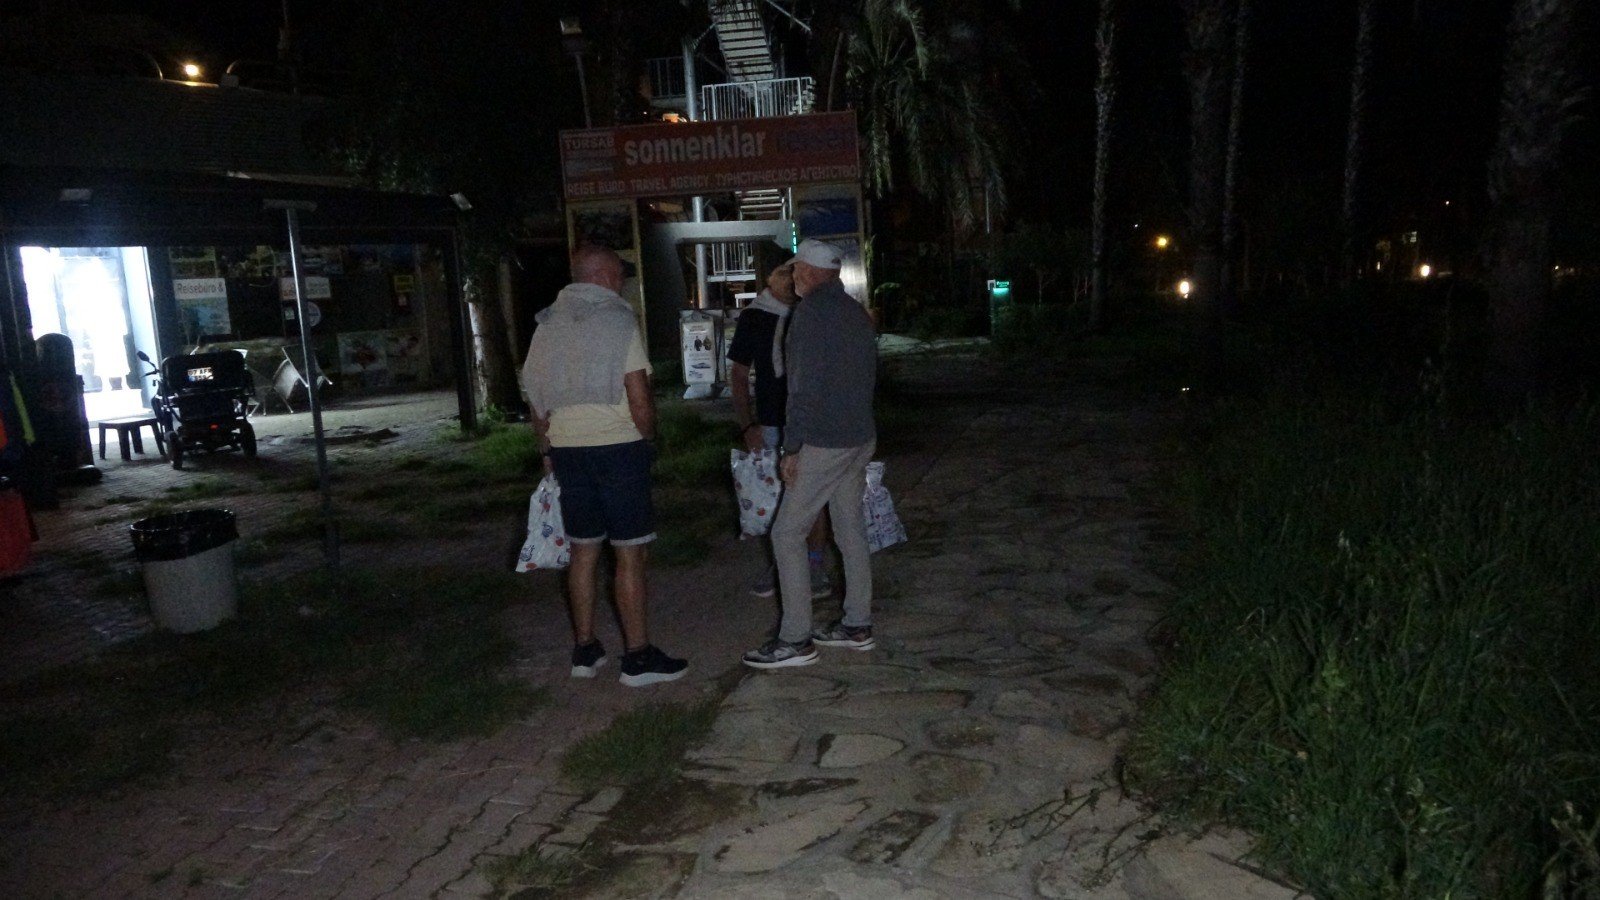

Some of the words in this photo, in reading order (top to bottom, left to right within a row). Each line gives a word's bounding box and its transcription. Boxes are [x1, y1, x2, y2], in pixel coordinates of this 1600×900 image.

[623, 125, 766, 166] sonnenklar
[567, 182, 596, 196] REISE
[630, 177, 668, 192] TRAVEL
[670, 174, 709, 189] AGENCY
